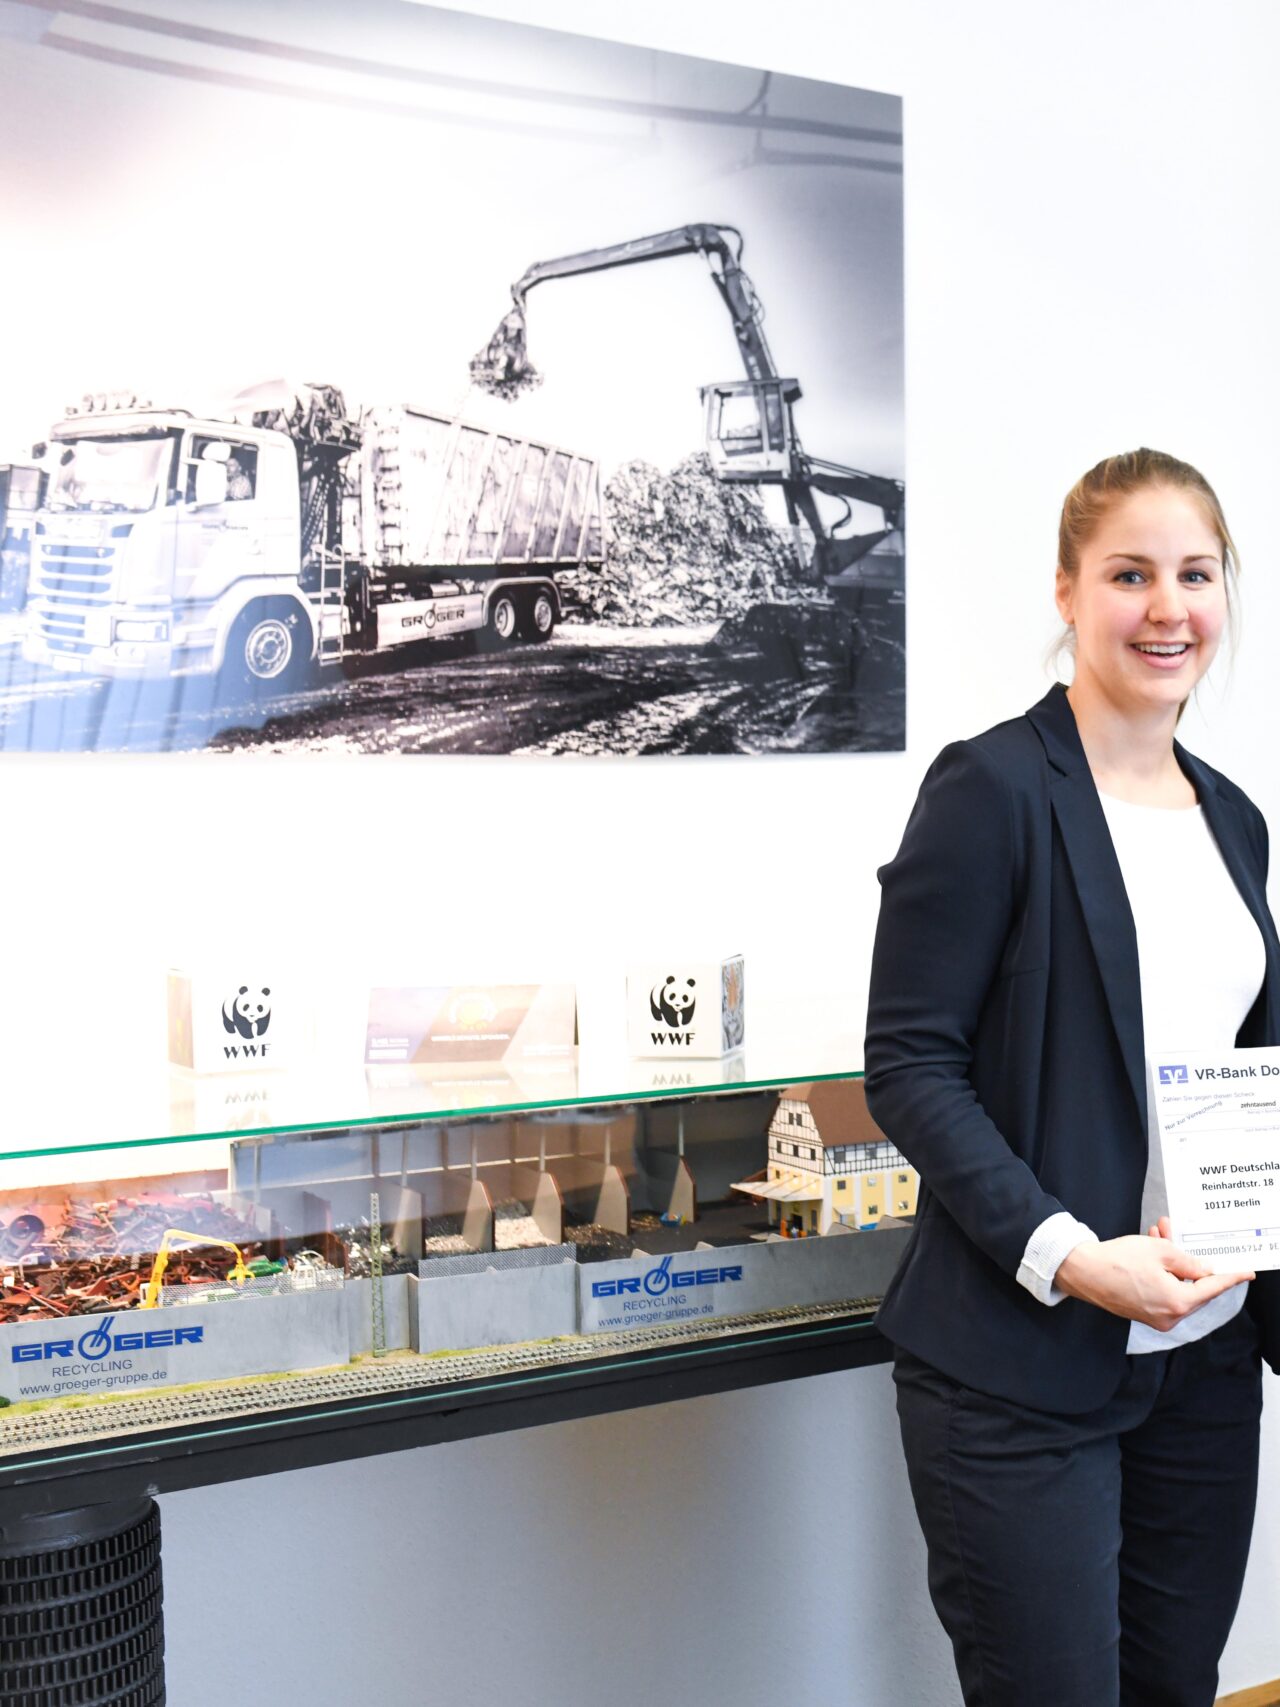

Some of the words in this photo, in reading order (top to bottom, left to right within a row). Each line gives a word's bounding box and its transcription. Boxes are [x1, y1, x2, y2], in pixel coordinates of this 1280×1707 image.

[650, 1032, 696, 1046] WWF
[224, 1043, 272, 1060] WWF
[1195, 1067, 1257, 1081] VR-Bank
[1199, 1163, 1228, 1176] WWF
[1201, 1179, 1262, 1191] Reinhardtstr.
[1263, 1178, 1274, 1187] 18
[1204, 1199, 1232, 1211] 10117
[1234, 1197, 1261, 1209] Berlin
[623, 1295, 687, 1311] RECYCLING
[598, 1303, 714, 1327] www.groeger-gruppe.de
[52, 1359, 133, 1377] RECYCLING
[19, 1370, 168, 1395] www.groeger-gruppe.de
